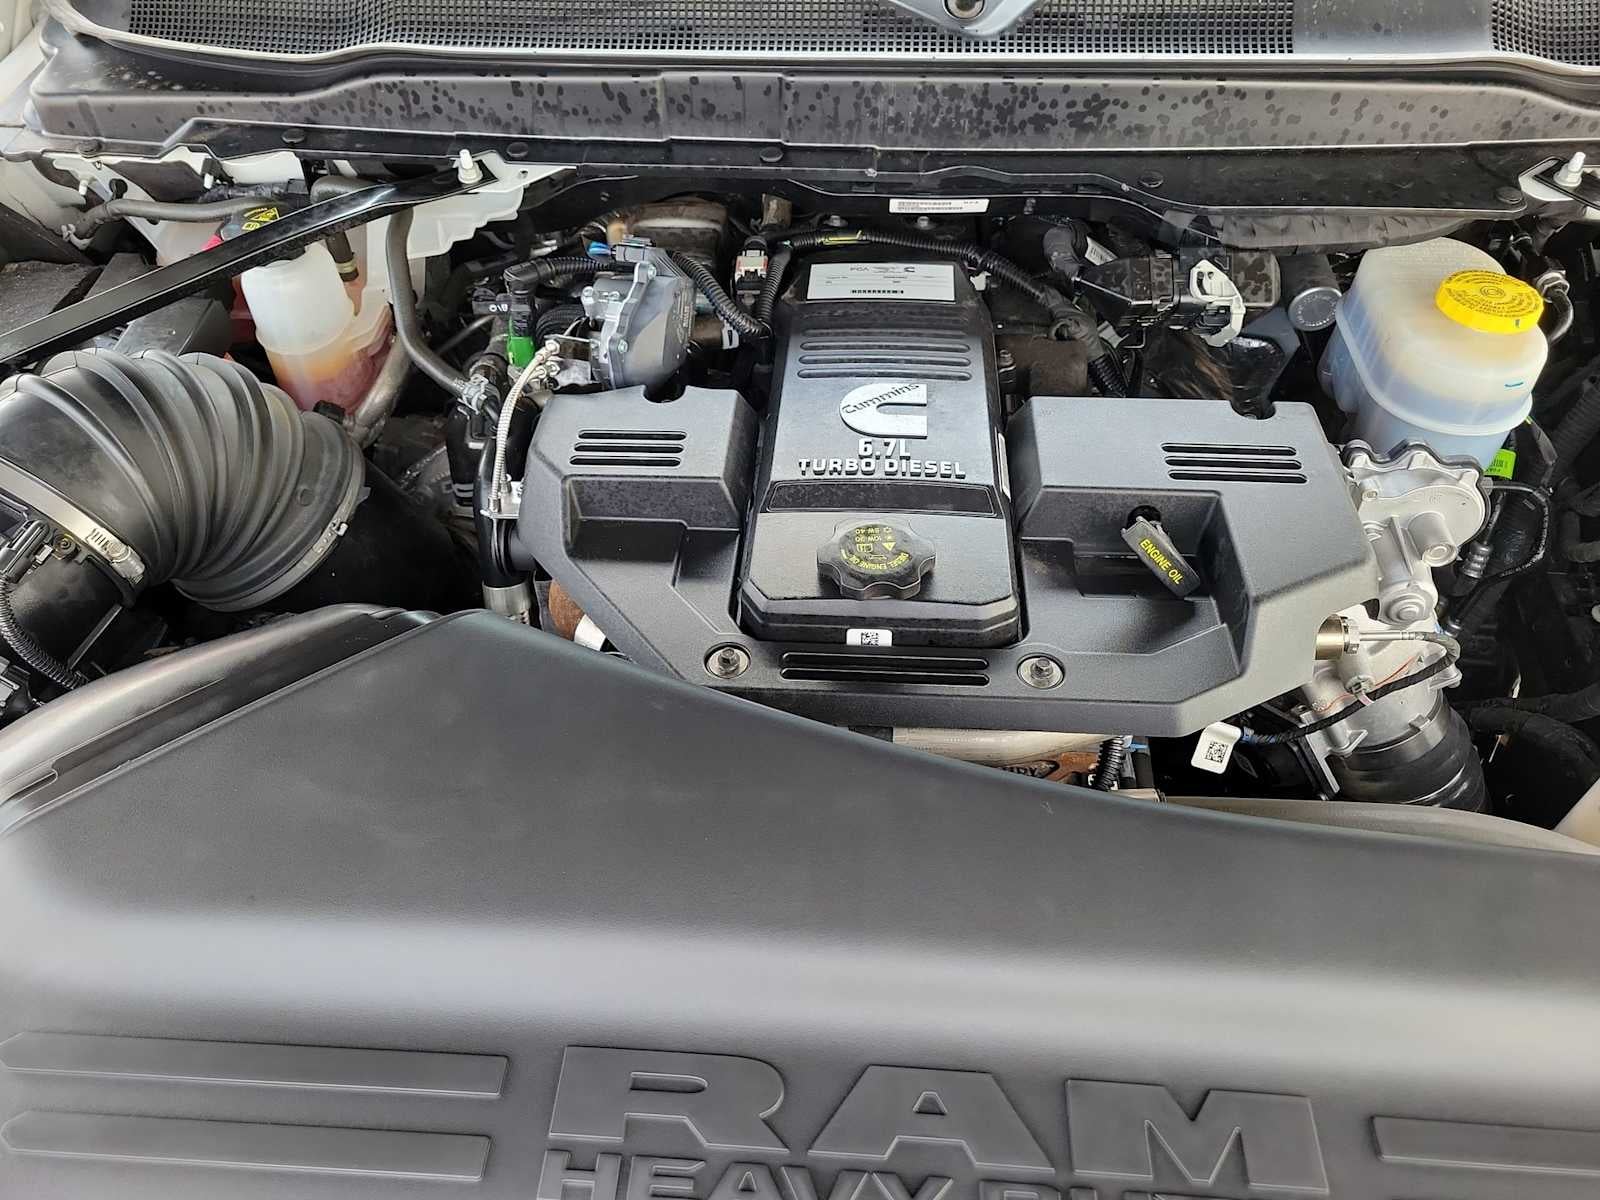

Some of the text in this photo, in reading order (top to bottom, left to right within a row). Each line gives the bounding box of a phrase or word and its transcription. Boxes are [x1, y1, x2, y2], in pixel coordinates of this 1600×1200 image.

[842, 383, 921, 414] Cummins
[858, 438, 911, 460] 6.7L
[799, 458, 966, 479] TURBO DIESEL
[1140, 539, 1184, 585] ENGINE OIL
[549, 1045, 1329, 1194] RAM
